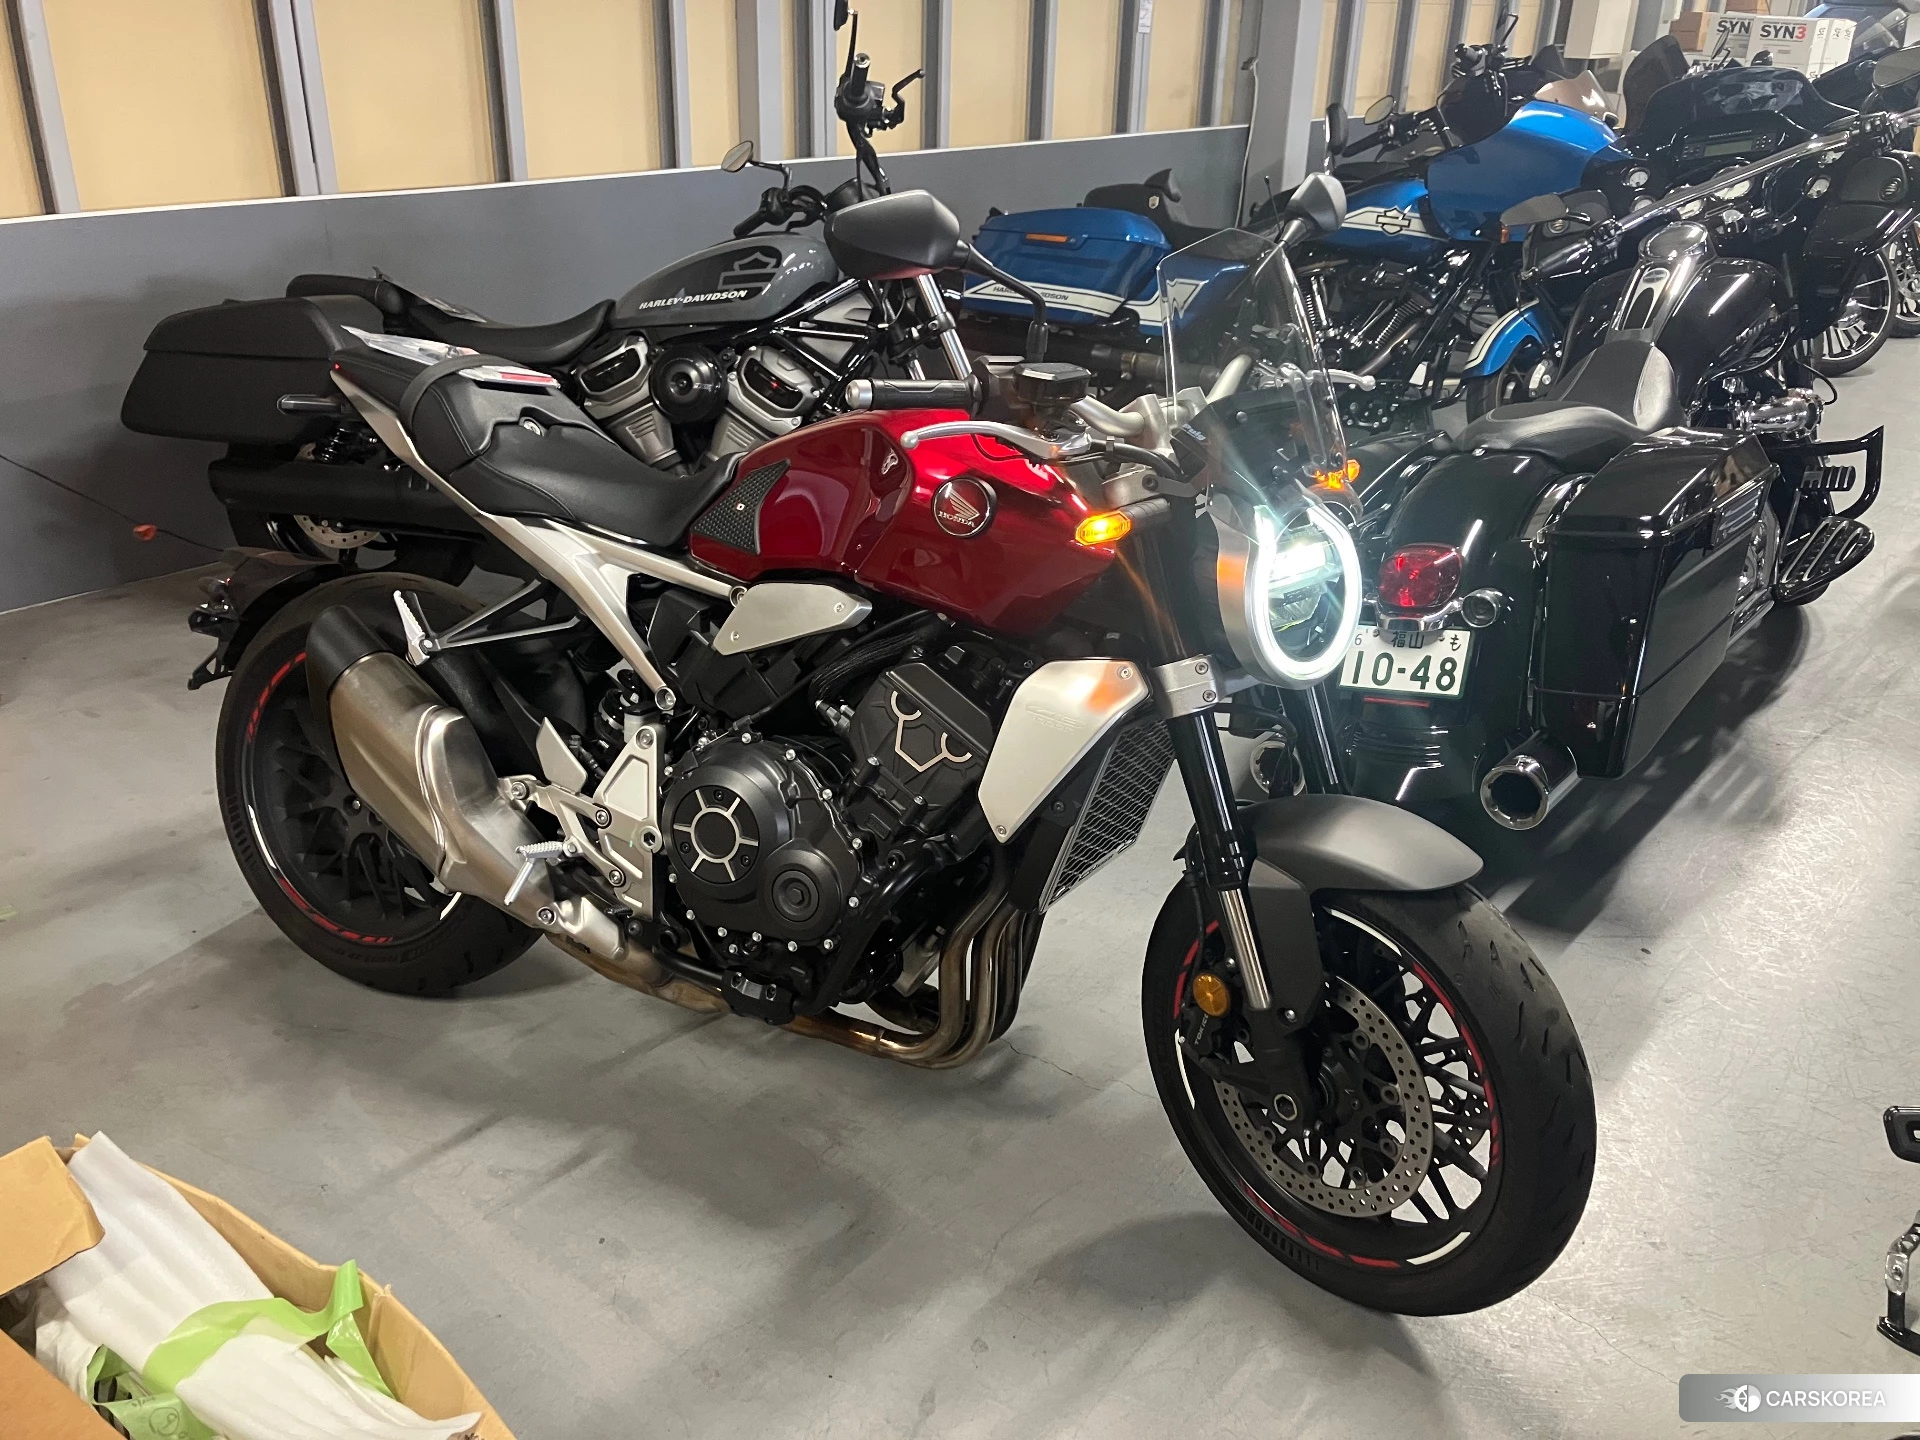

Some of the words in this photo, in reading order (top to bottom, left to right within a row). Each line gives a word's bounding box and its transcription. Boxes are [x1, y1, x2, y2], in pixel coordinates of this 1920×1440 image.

[1717, 20, 1750, 34] SYN
[1759, 24, 1806, 40] SYN3
[639, 289, 748, 309] HARLEY-DAVIDSON
[938, 510, 975, 527] HONDA
[1391, 630, 1425, 650] 福山
[1449, 633, 1462, 652] も
[1352, 650, 1458, 692] 10-48
